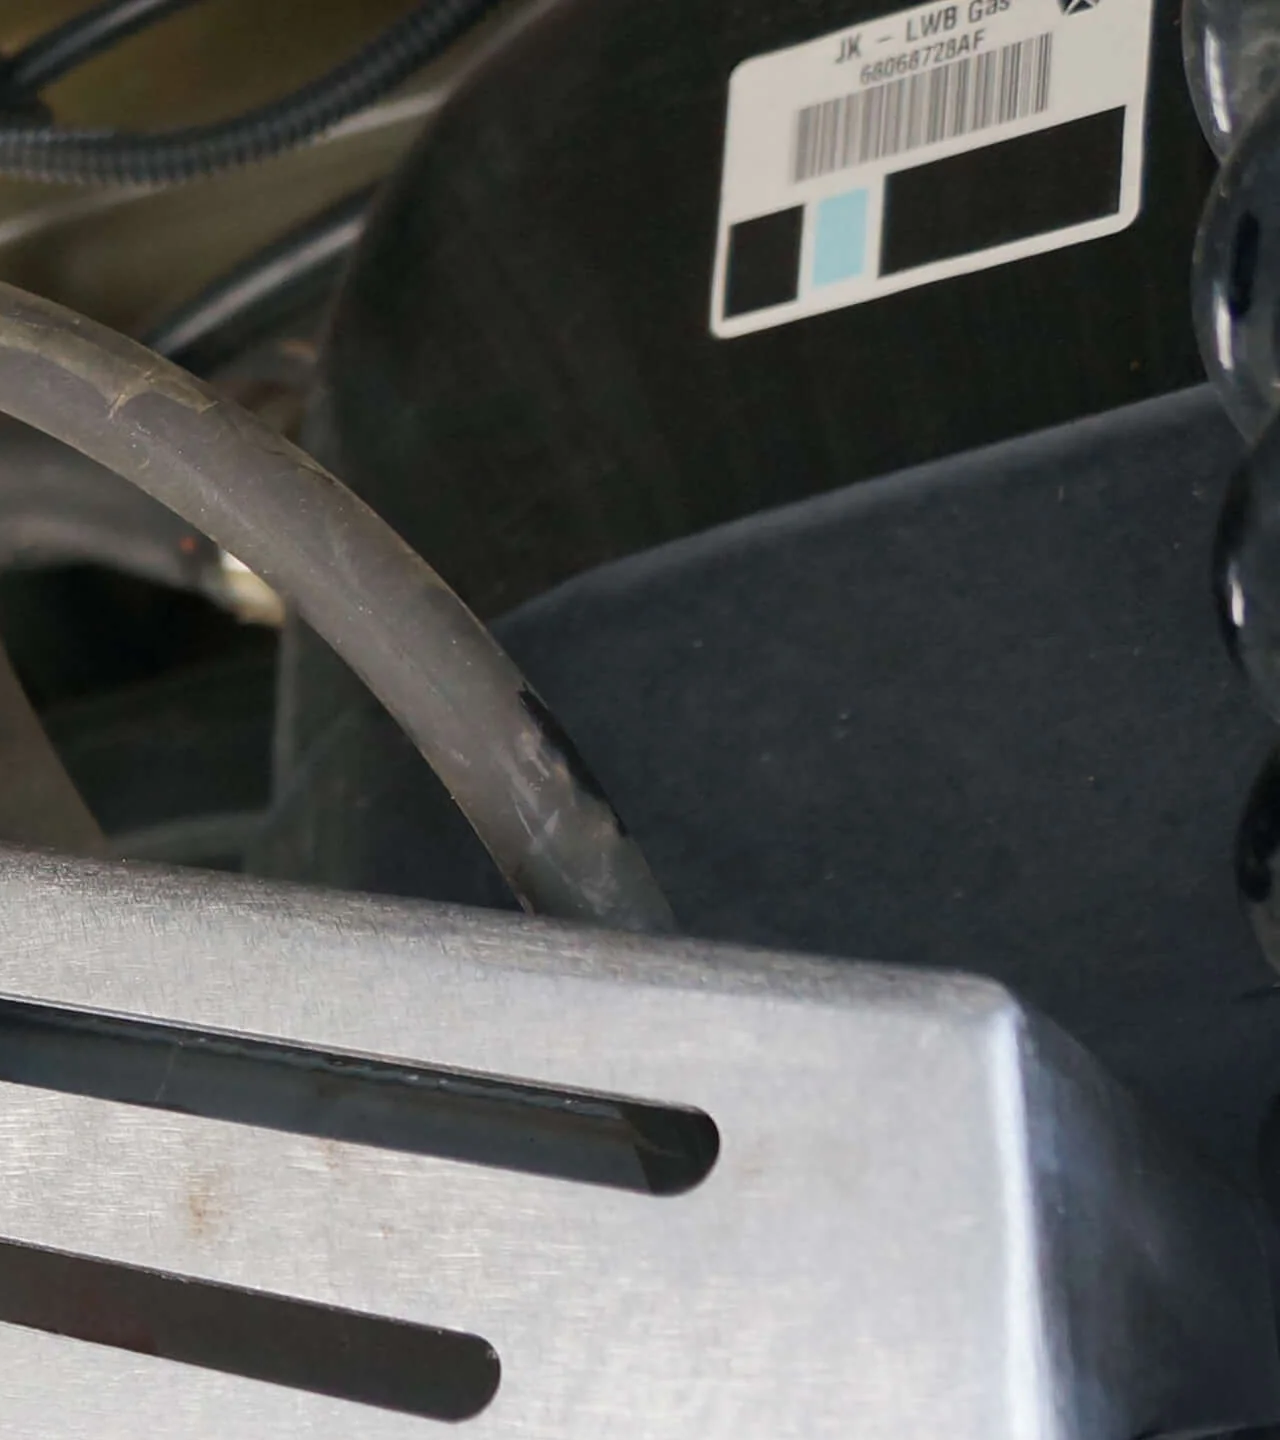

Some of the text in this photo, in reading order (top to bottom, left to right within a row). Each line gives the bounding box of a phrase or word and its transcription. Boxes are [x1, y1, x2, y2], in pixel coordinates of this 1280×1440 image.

[835, 33, 863, 64] JK
[906, 6, 958, 42] LWB
[968, 0, 1011, 23] Gas
